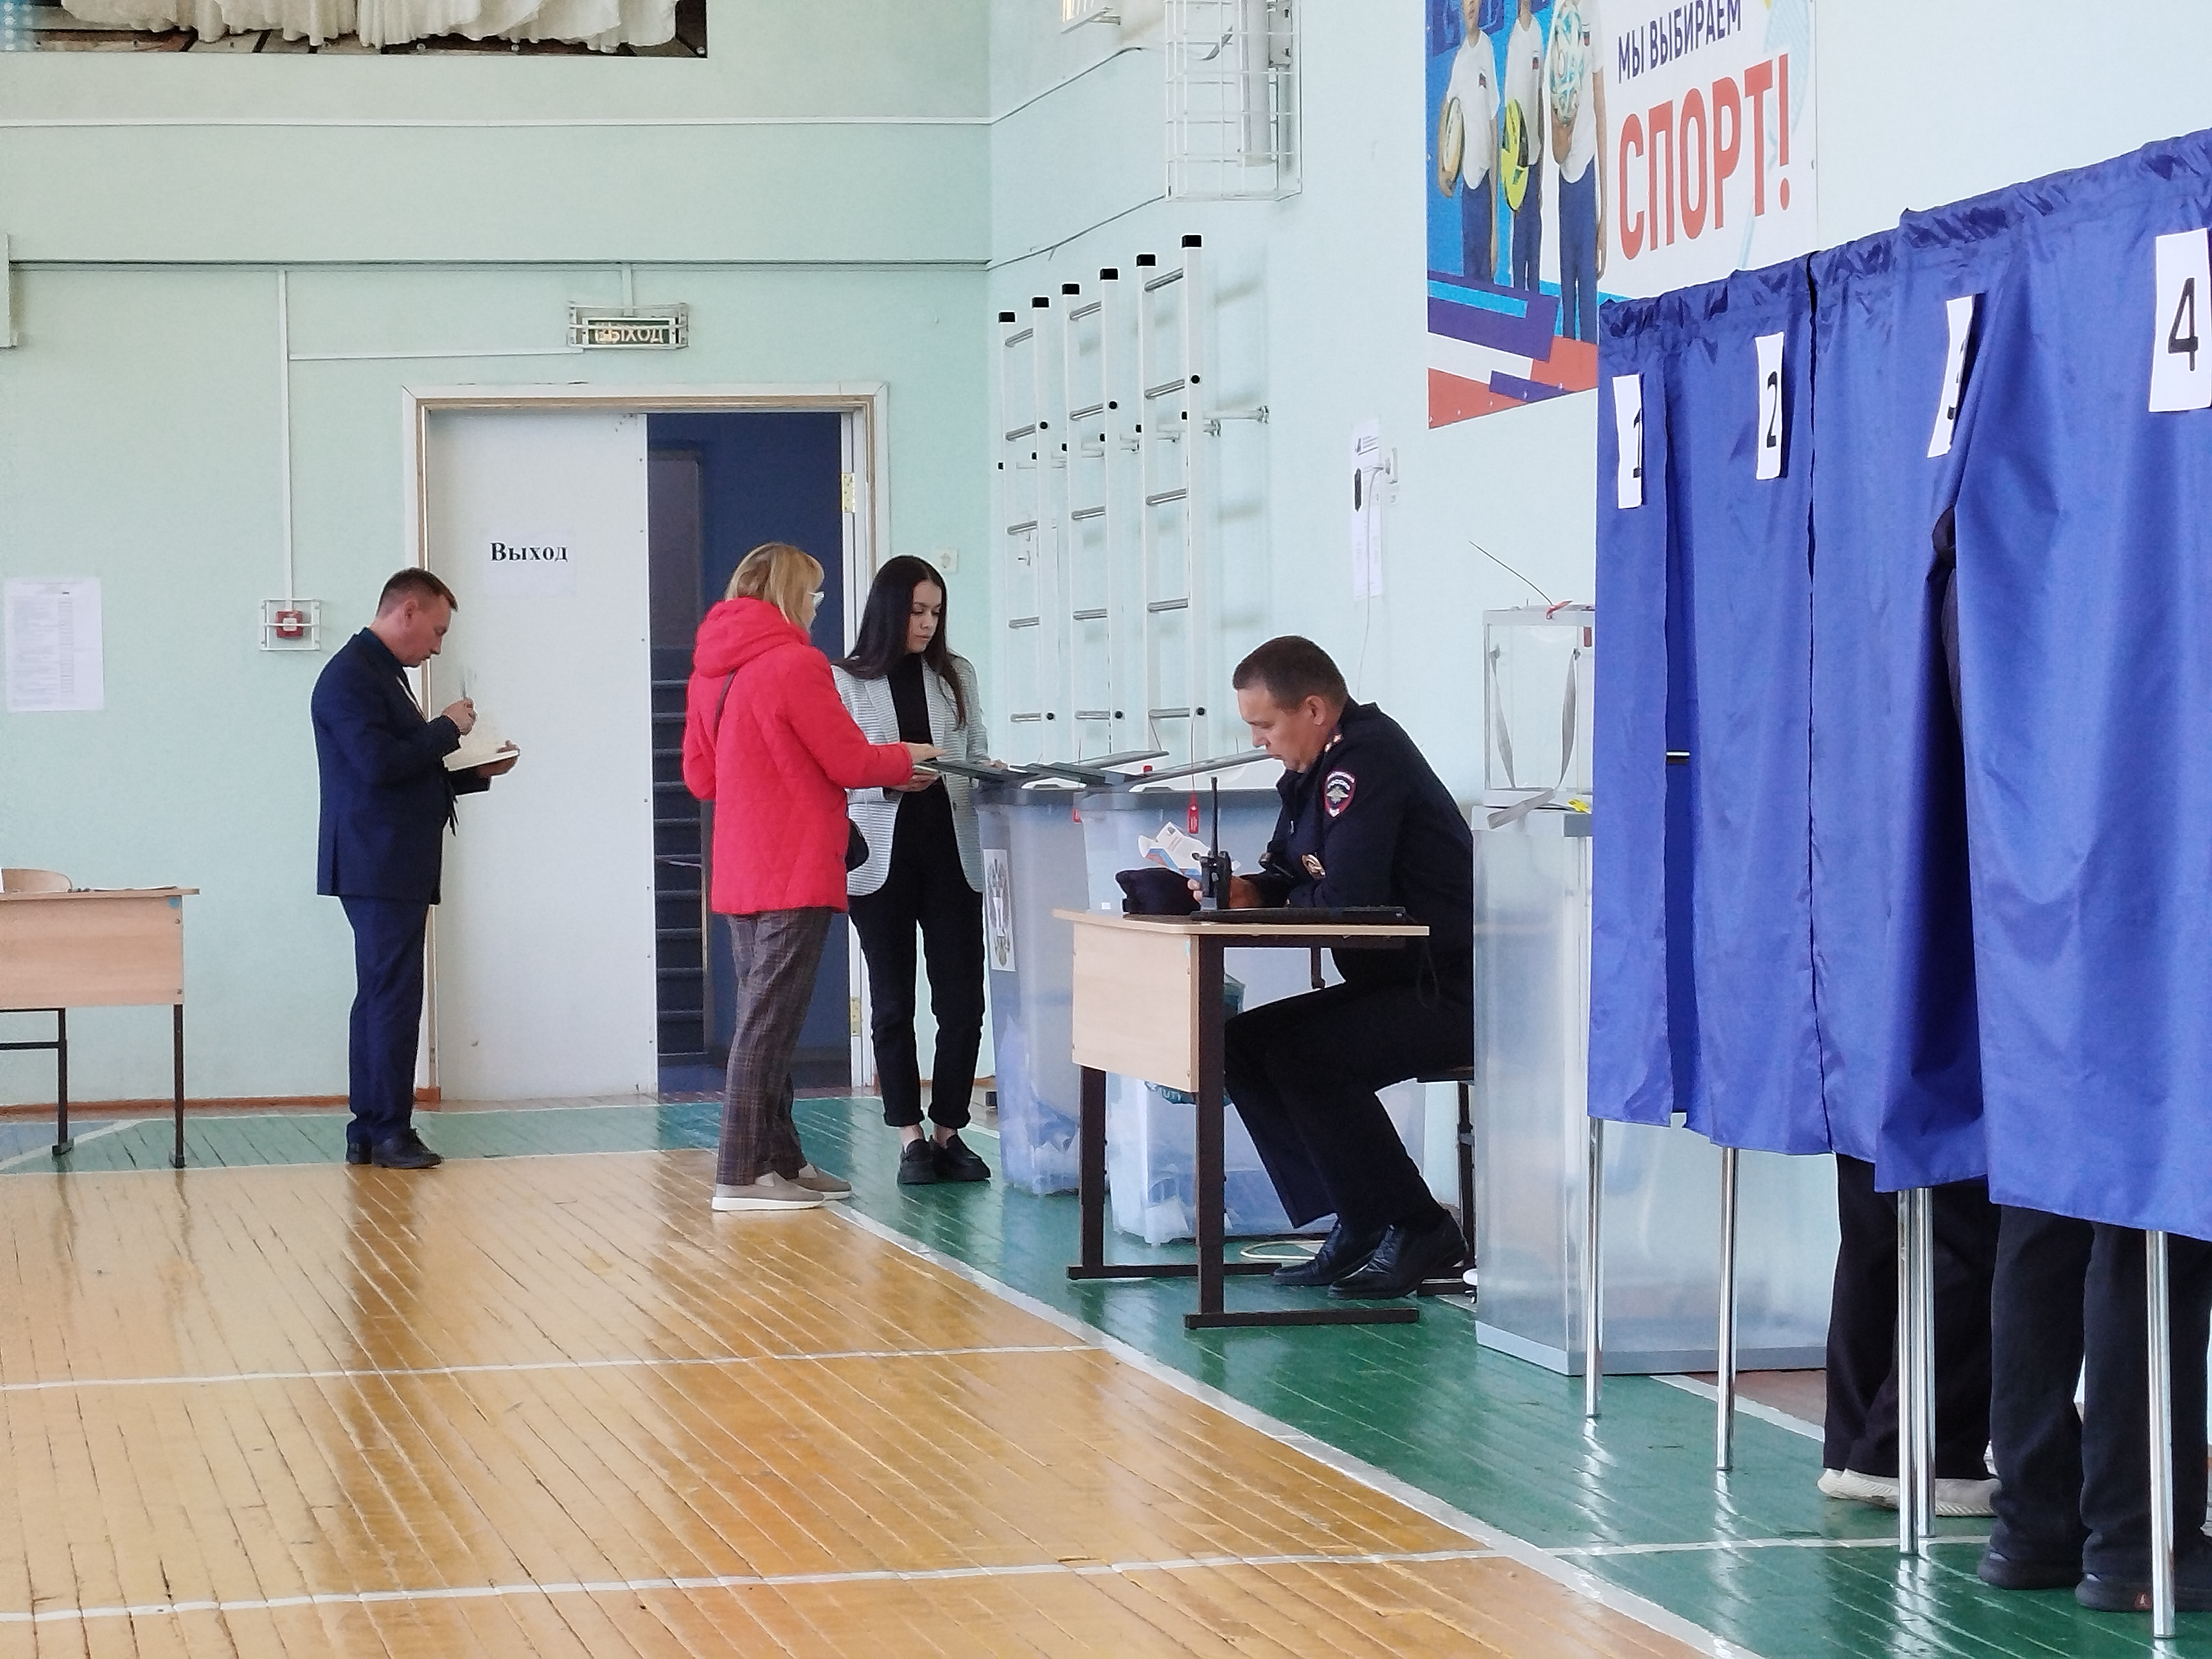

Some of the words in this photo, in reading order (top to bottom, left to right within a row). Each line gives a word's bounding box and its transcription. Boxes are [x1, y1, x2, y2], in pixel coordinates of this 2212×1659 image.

[1618, 25, 1644, 84] МЫ
[1650, 0, 1741, 70] ВЫБИРАЕМ
[1619, 53, 1790, 260] СПОРТ!
[2168, 277, 2199, 372] 4
[1766, 371, 1778, 448] 2
[490, 542, 568, 562] Выход
